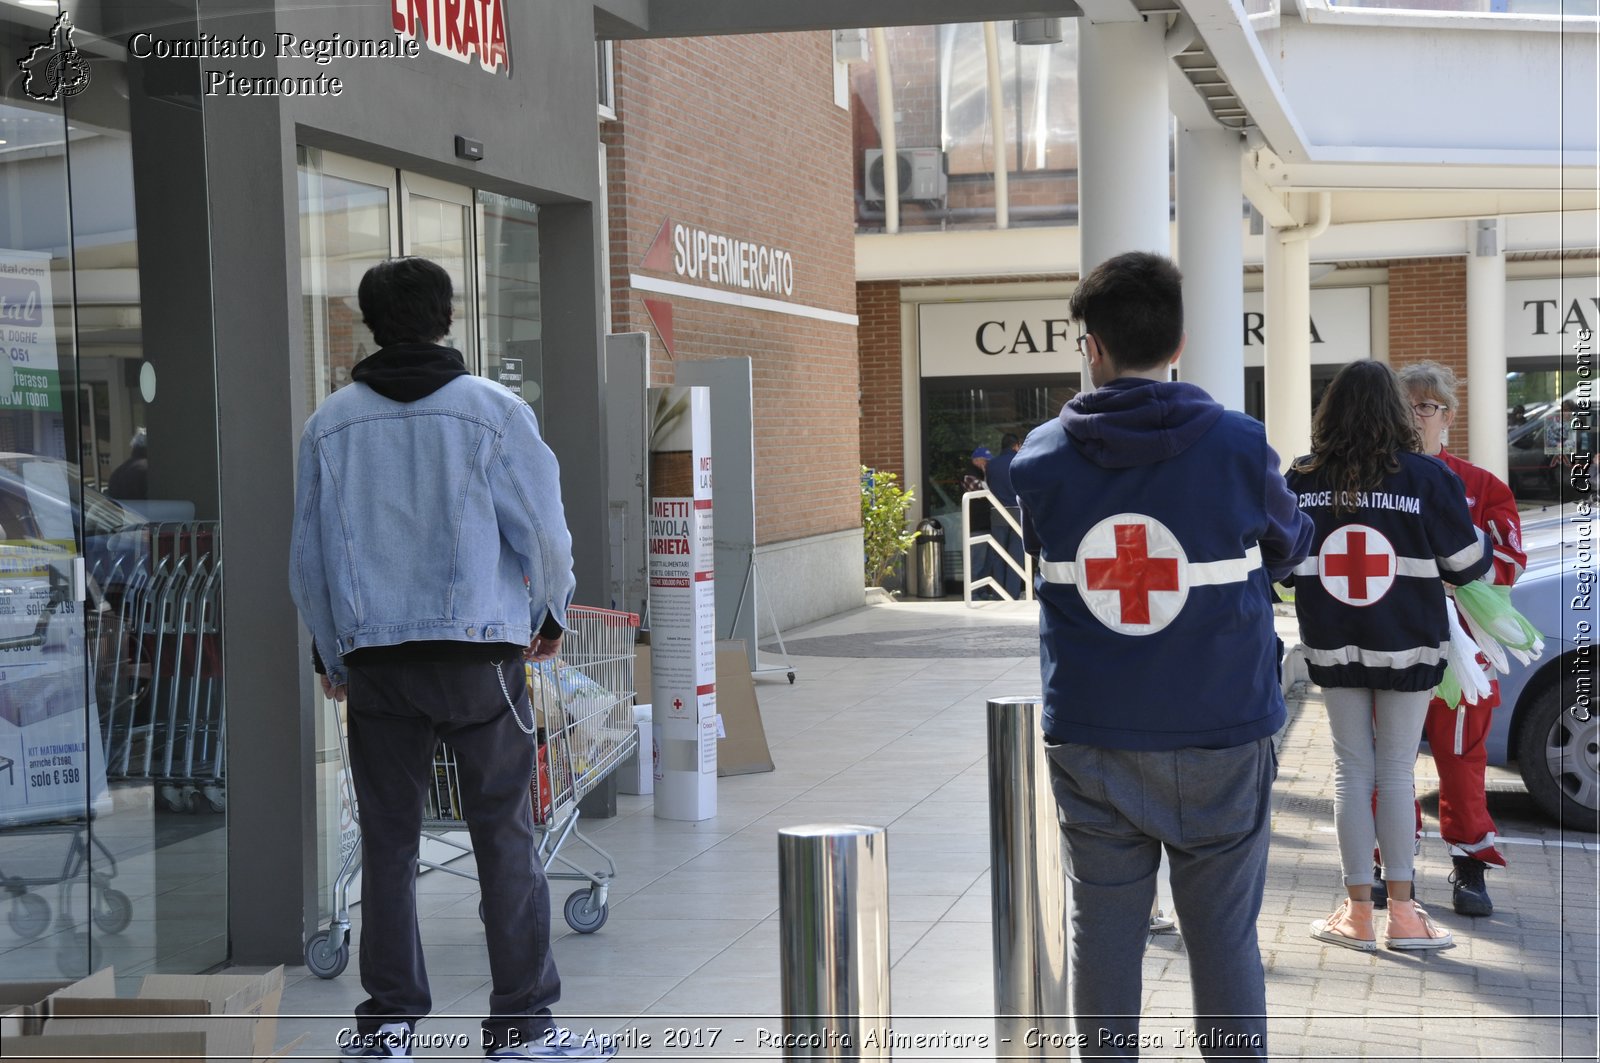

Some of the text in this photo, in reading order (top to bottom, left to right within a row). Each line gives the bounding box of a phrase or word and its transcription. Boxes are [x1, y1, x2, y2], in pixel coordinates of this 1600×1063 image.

[674, 224, 793, 297] SUPERMERCATO
[9, 331, 37, 344] DOGHE
[26, 392, 48, 407] room
[655, 502, 688, 517] METTI
[1299, 490, 1420, 514] CROCE OSA ITALIANA
[650, 521, 690, 536] TAVOLA
[28, 747, 38, 757] KIT
[31, 768, 80, 788] solo € 598
[342, 830, 356, 842] NON
